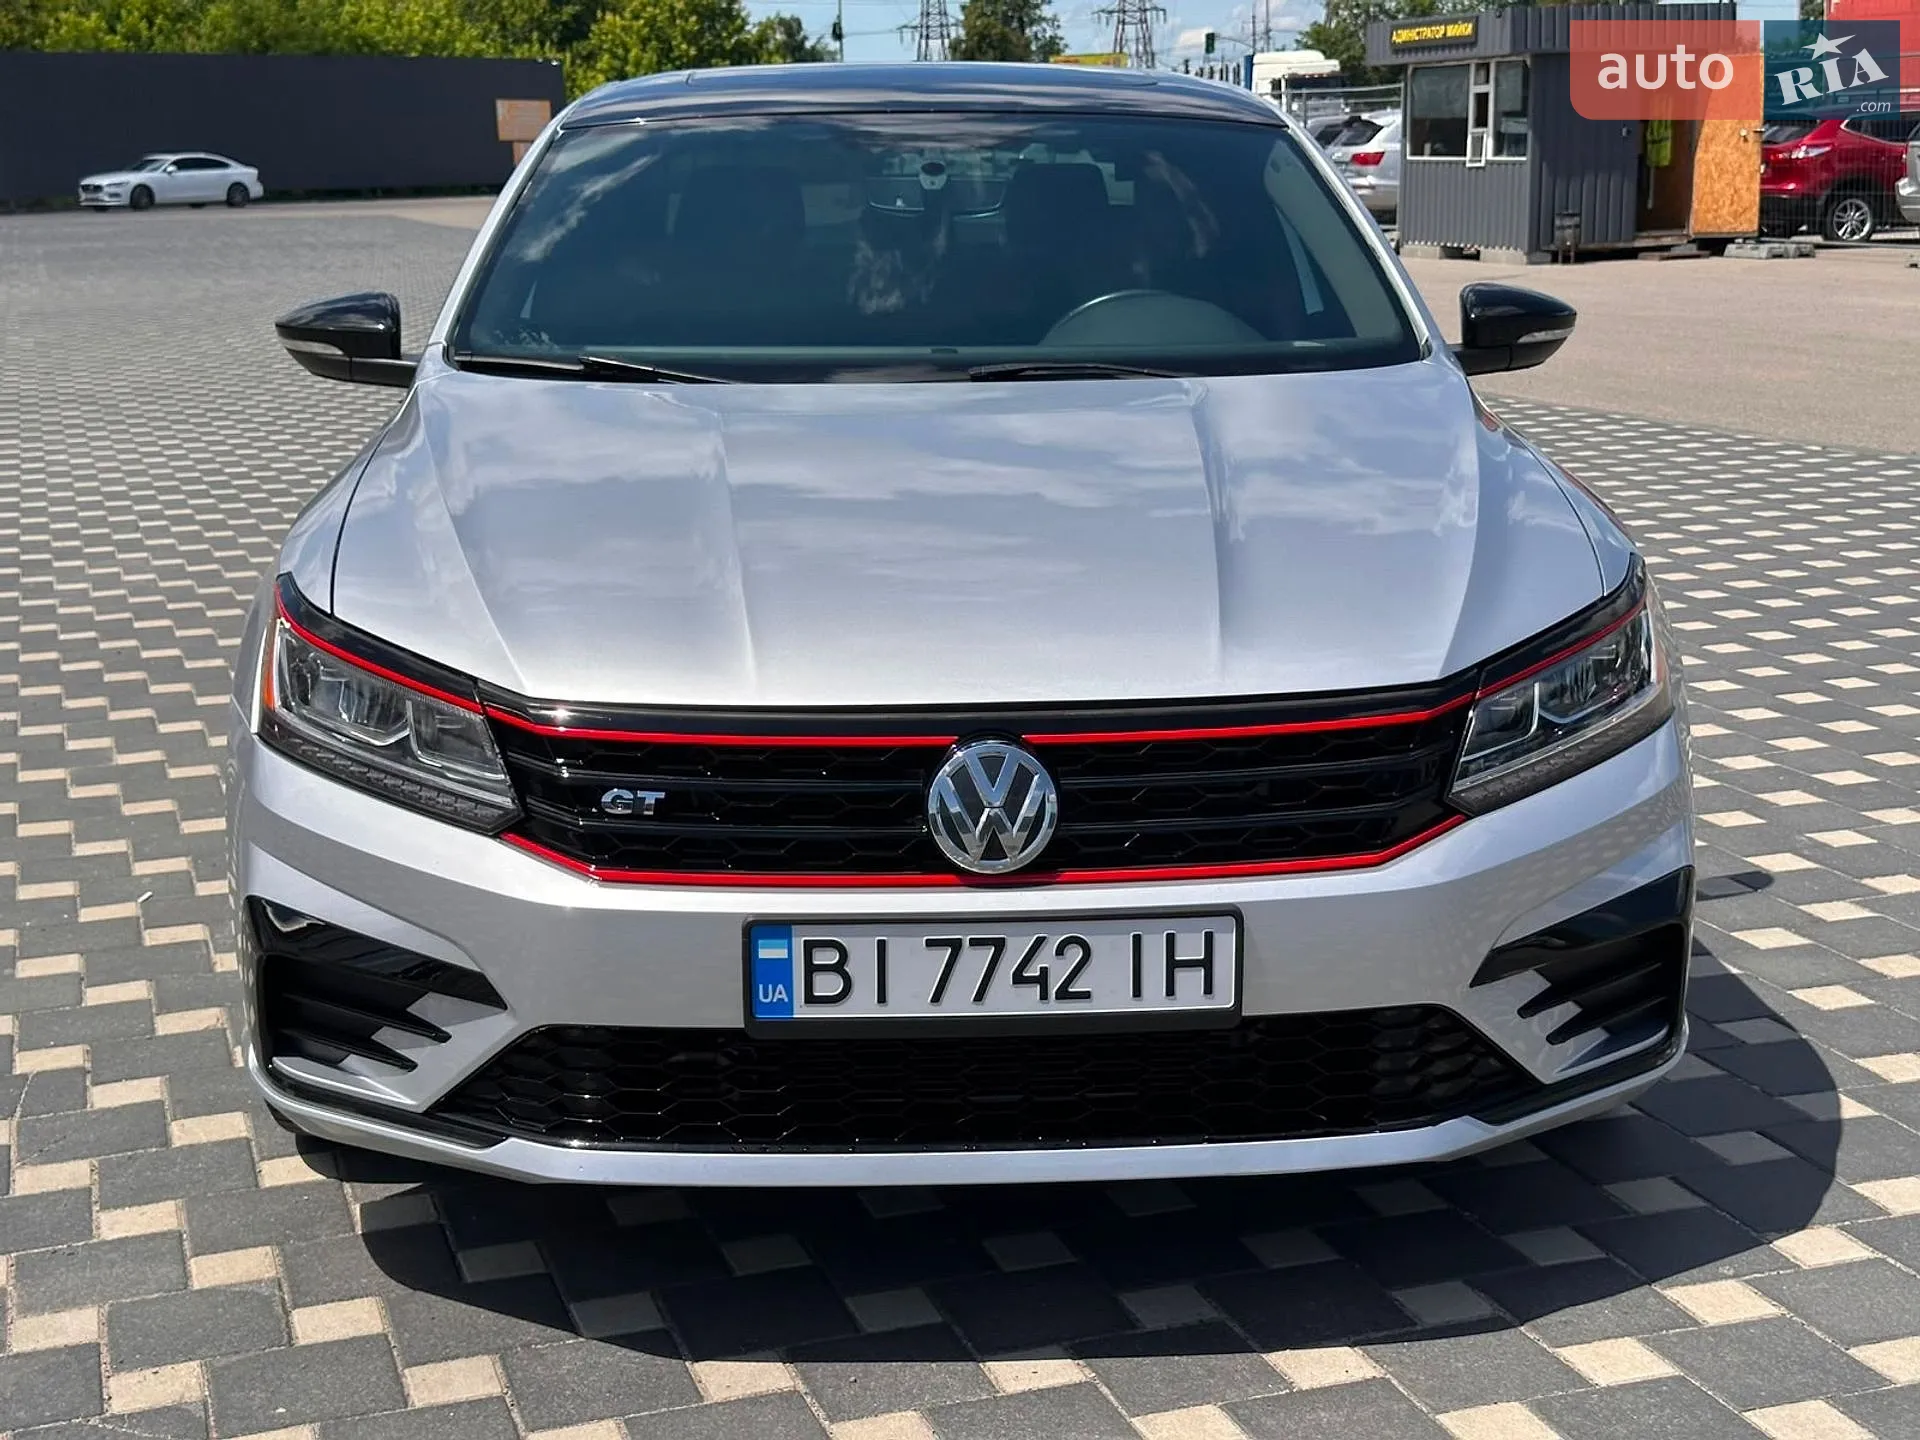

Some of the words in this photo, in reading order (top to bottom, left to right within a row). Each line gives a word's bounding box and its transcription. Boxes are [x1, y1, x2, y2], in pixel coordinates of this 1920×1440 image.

[601, 788, 665, 815] GT
[923, 933, 1092, 1005] 7742
[758, 982, 789, 1004] UA
